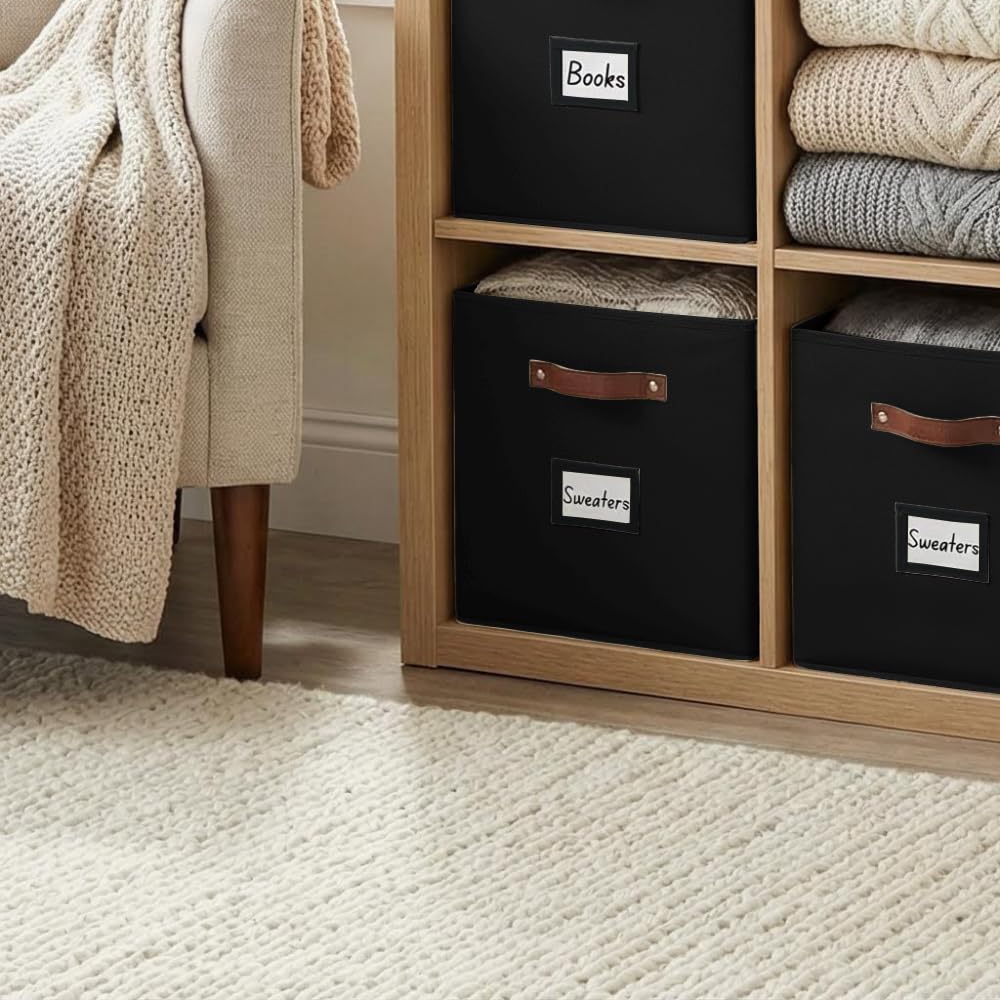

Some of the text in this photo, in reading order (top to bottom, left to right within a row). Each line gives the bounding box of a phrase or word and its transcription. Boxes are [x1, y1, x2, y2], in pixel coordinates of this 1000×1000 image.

[567, 60, 625, 88] Books
[563, 485, 630, 510] Sweaters
[908, 528, 979, 555] Sweaters
